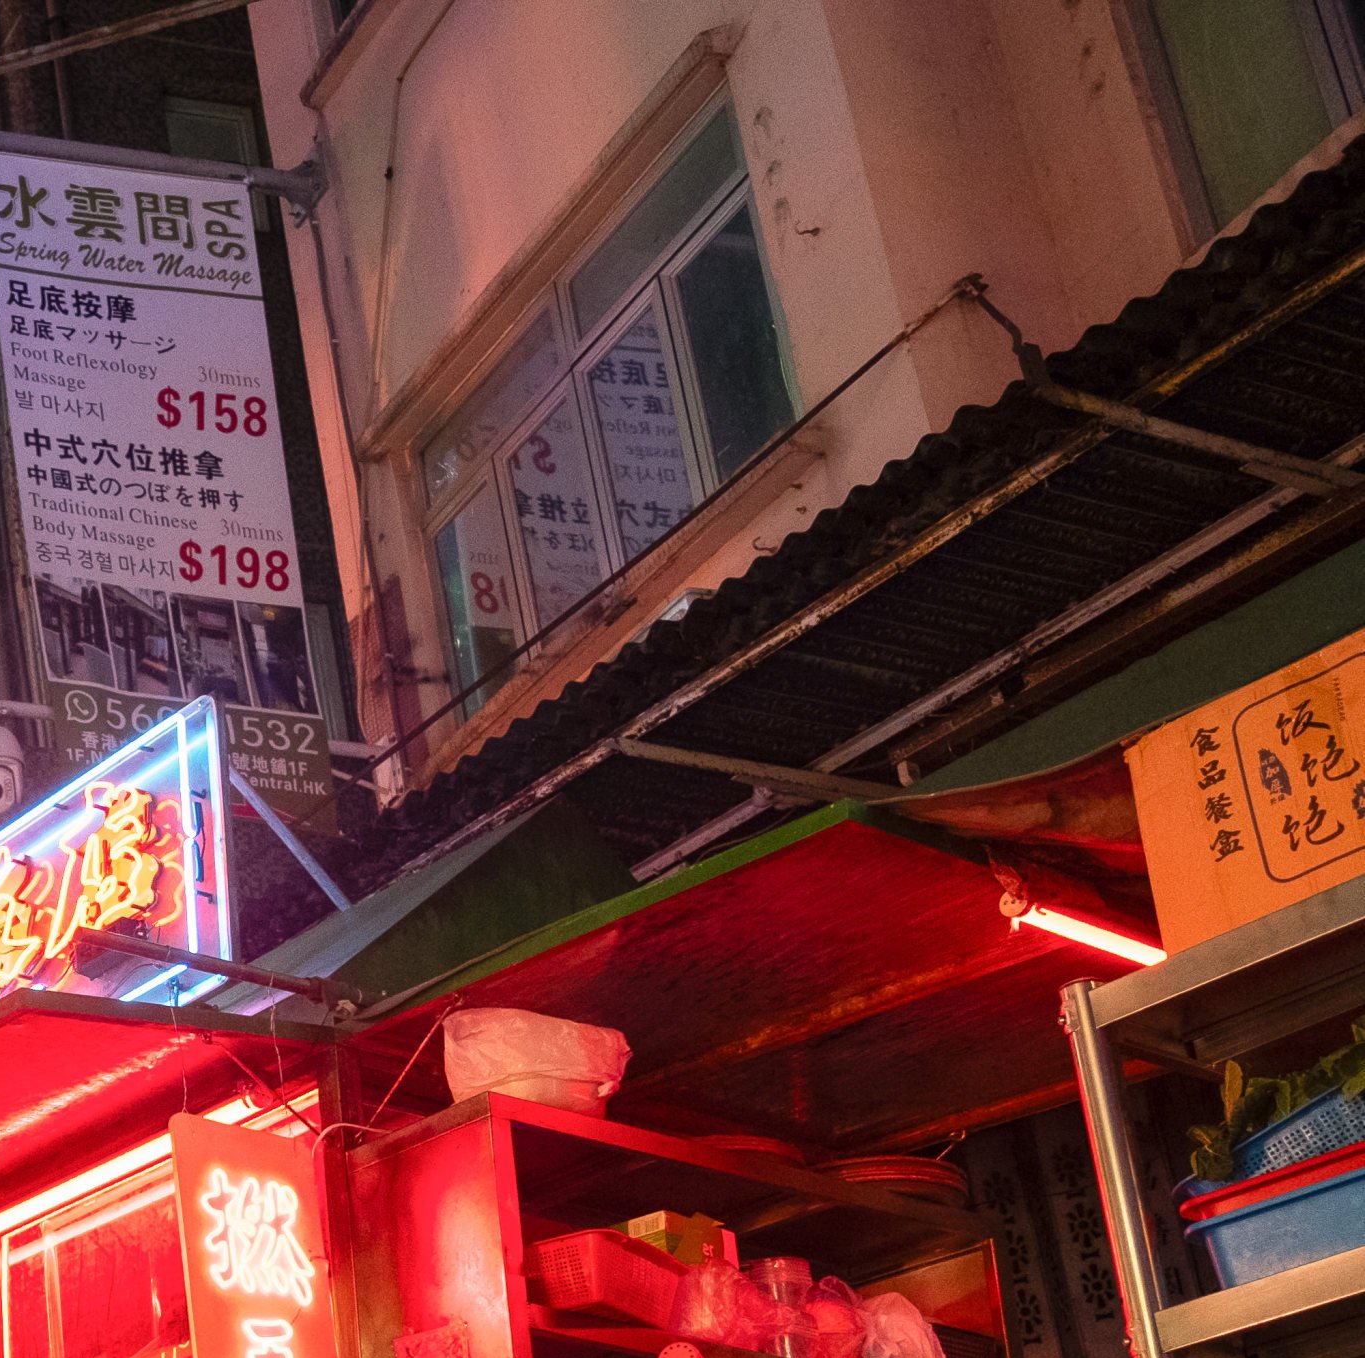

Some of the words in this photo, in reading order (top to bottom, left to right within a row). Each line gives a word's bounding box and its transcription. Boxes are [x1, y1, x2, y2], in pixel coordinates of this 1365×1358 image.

[201, 199, 246, 262] SPA
[78, 244, 147, 275] Water
[153, 253, 254, 288] Massage
[6, 279, 137, 323] 足底按摩
[9, 315, 177, 355] 足底マッサージ
[10, 342, 49, 363] Foot
[53, 348, 158, 381] Reflexology
[13, 363, 86, 391] Massage
[197, 366, 261, 389] 30mins
[40, 395, 105, 422] 마사지
[156, 386, 268, 437] $158
[23, 427, 225, 481] 中式穴位推拿
[26, 463, 245, 514] 中國式のつぼを押す
[27, 491, 125, 521] Traditional
[129, 506, 199, 531] Chinese
[219, 518, 284, 543] 30mins
[32, 515, 76, 540] Body
[81, 521, 156, 550] Massage
[119, 554, 175, 584] 마사지
[178, 538, 290, 592] $198
[238, 772, 328, 796] entral.HK
